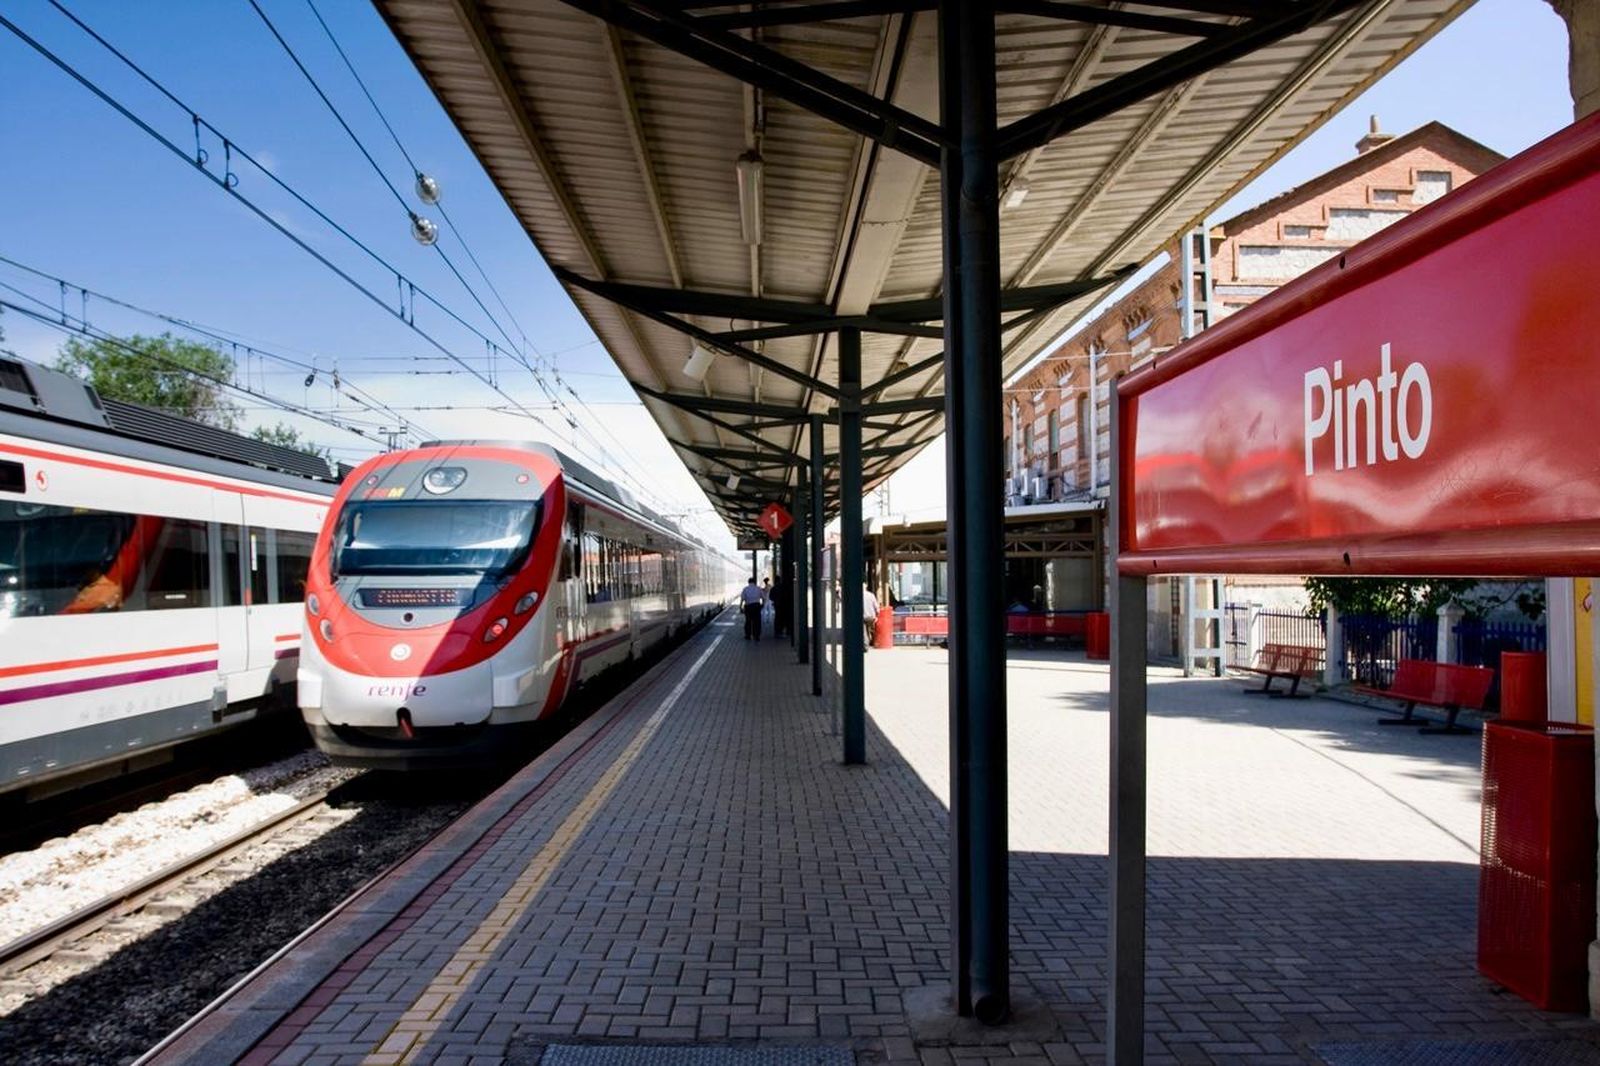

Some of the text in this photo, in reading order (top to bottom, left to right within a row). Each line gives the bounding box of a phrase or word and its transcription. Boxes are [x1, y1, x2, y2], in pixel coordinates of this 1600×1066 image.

[1304, 342, 1433, 476] Pinto
[770, 511, 779, 530] 1
[368, 683, 427, 701] renfe
